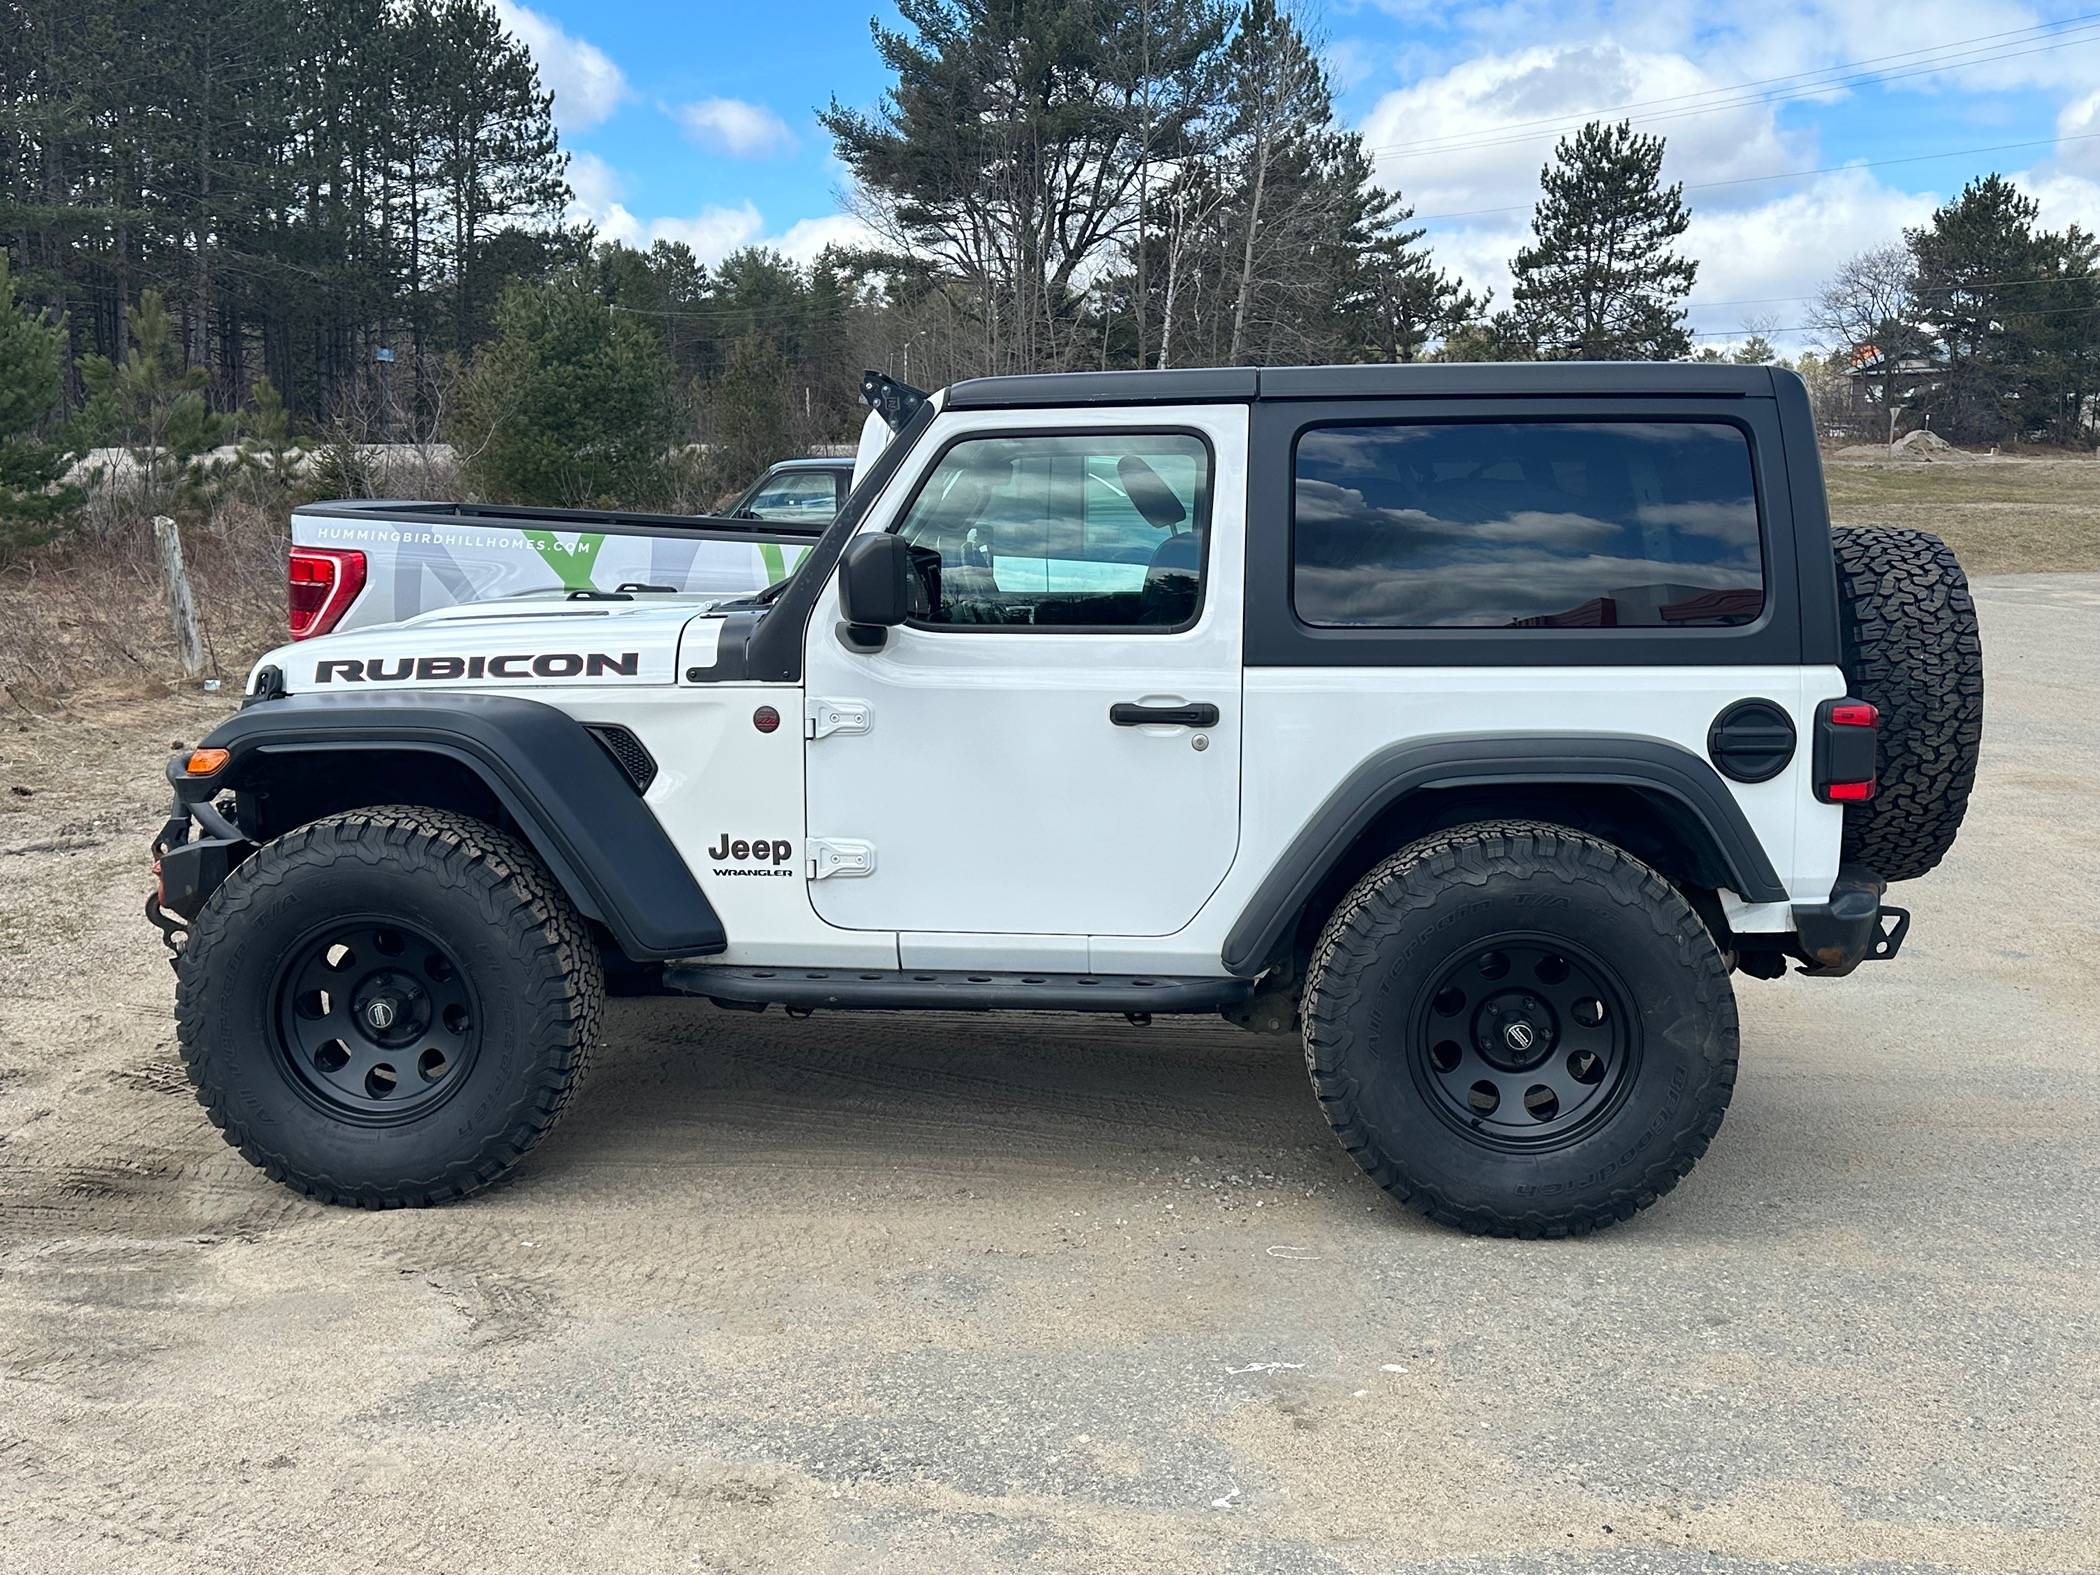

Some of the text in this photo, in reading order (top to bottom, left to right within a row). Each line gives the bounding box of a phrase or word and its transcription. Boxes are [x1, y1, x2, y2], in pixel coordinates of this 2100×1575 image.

[317, 527, 590, 554] HUMMINGBIRDHILLHOMES.COM
[315, 652, 639, 684] RUBICON
[708, 833, 792, 866] Jeep
[712, 868, 793, 877] WRANGLER
